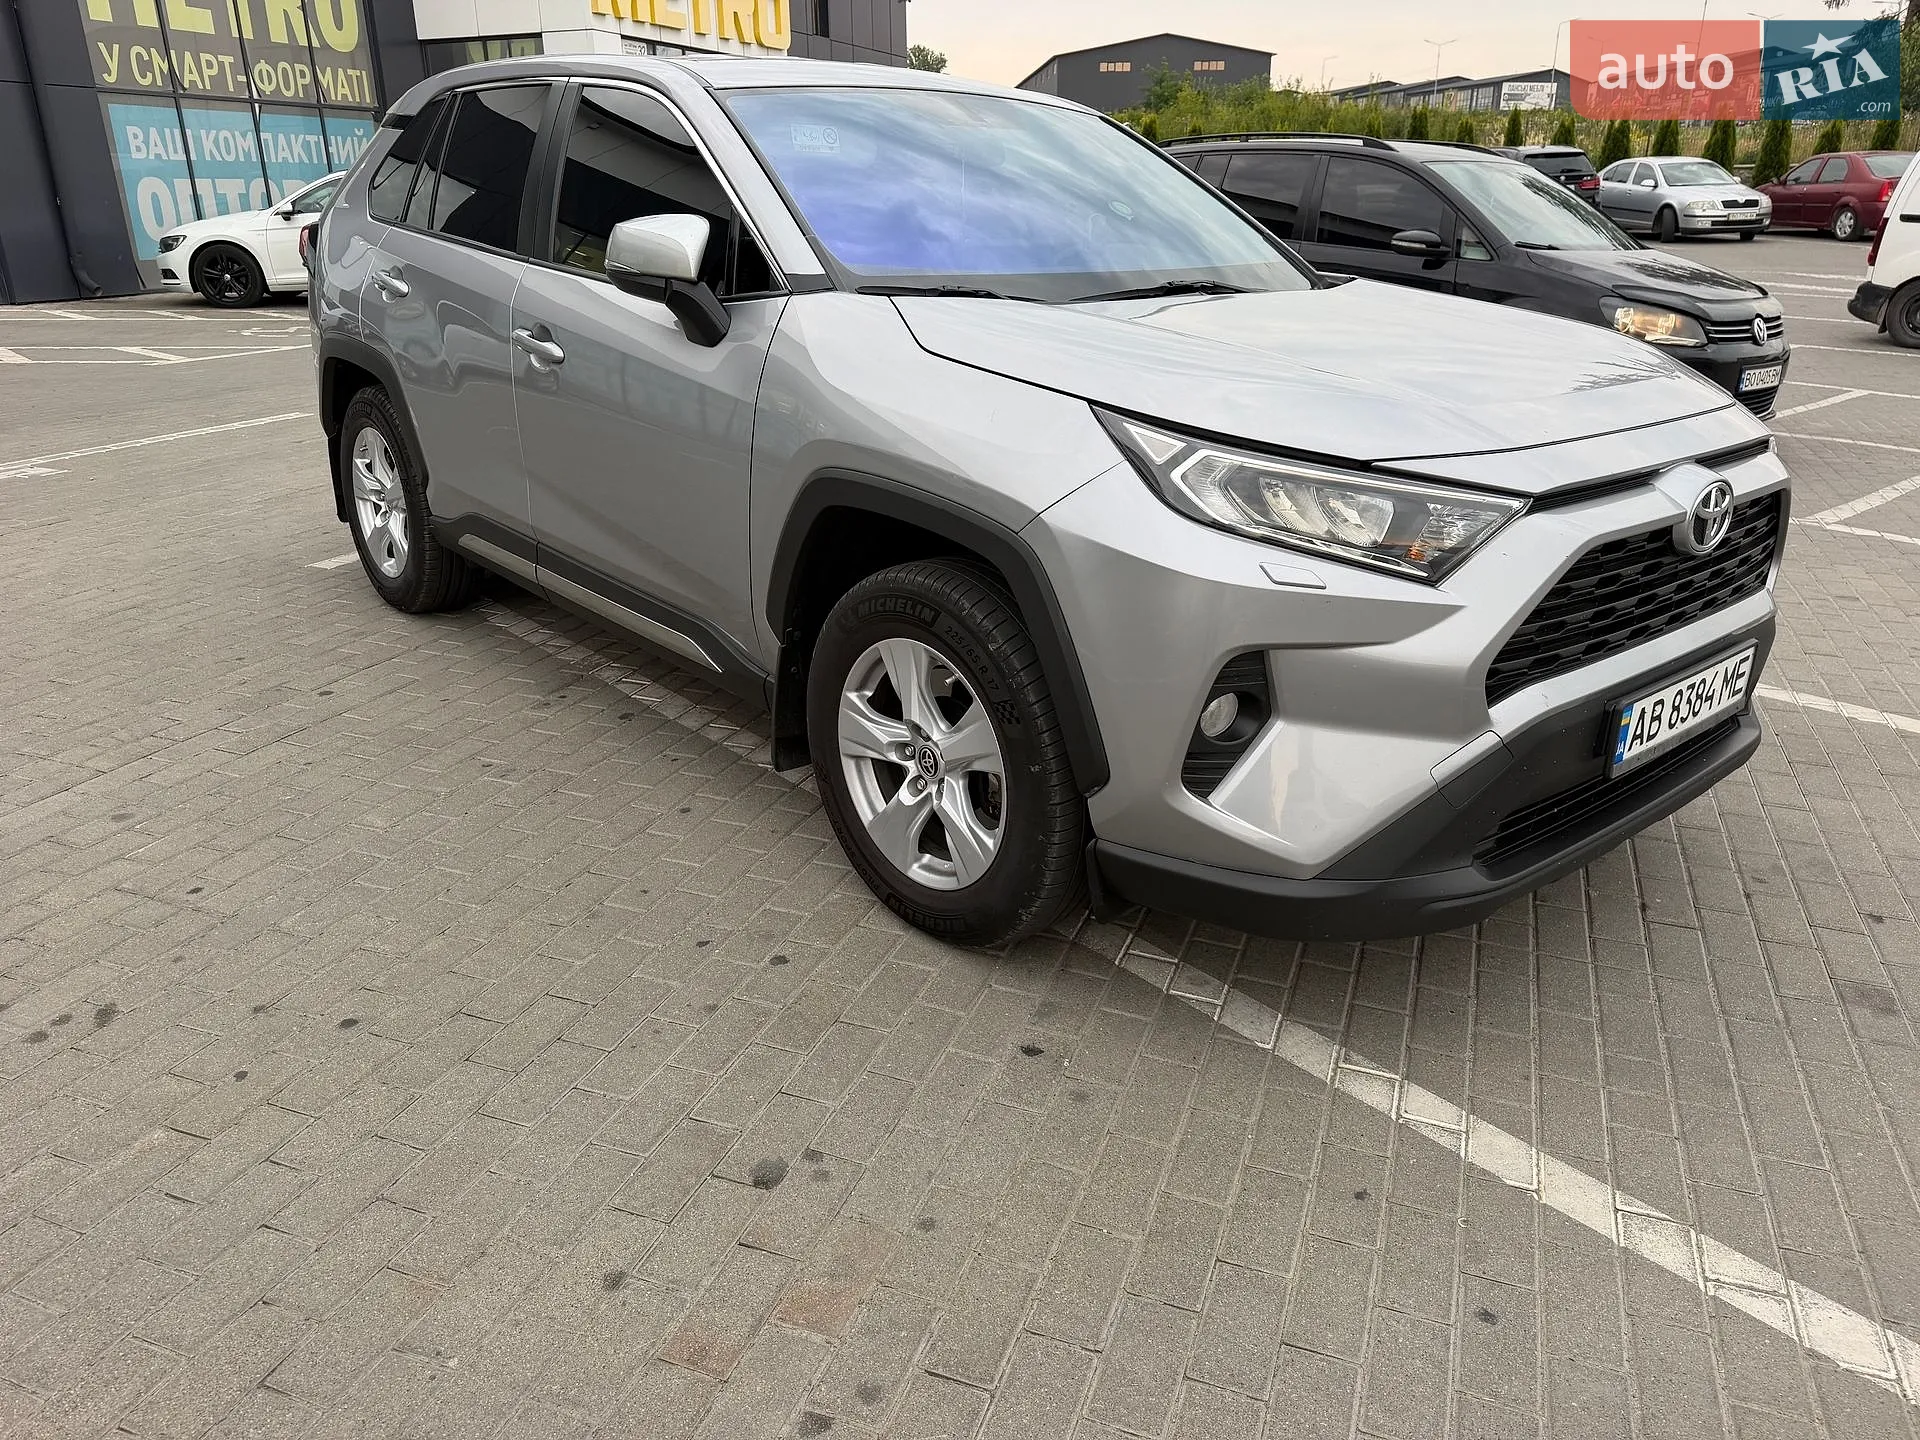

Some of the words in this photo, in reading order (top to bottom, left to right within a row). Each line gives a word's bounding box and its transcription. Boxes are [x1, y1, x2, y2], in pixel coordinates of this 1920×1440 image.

[97, 42, 119, 83] У
[130, 45, 370, 103] СМАРТ-ФОРМАТІ
[126, 125, 196, 162] ВАШ
[136, 176, 308, 242] ОПТ
[857, 597, 936, 622] MICHELIN
[944, 625, 981, 664] 225/65
[1628, 698, 1665, 752] AB
[1668, 671, 1719, 730] 8384
[1717, 654, 1750, 706] ME
